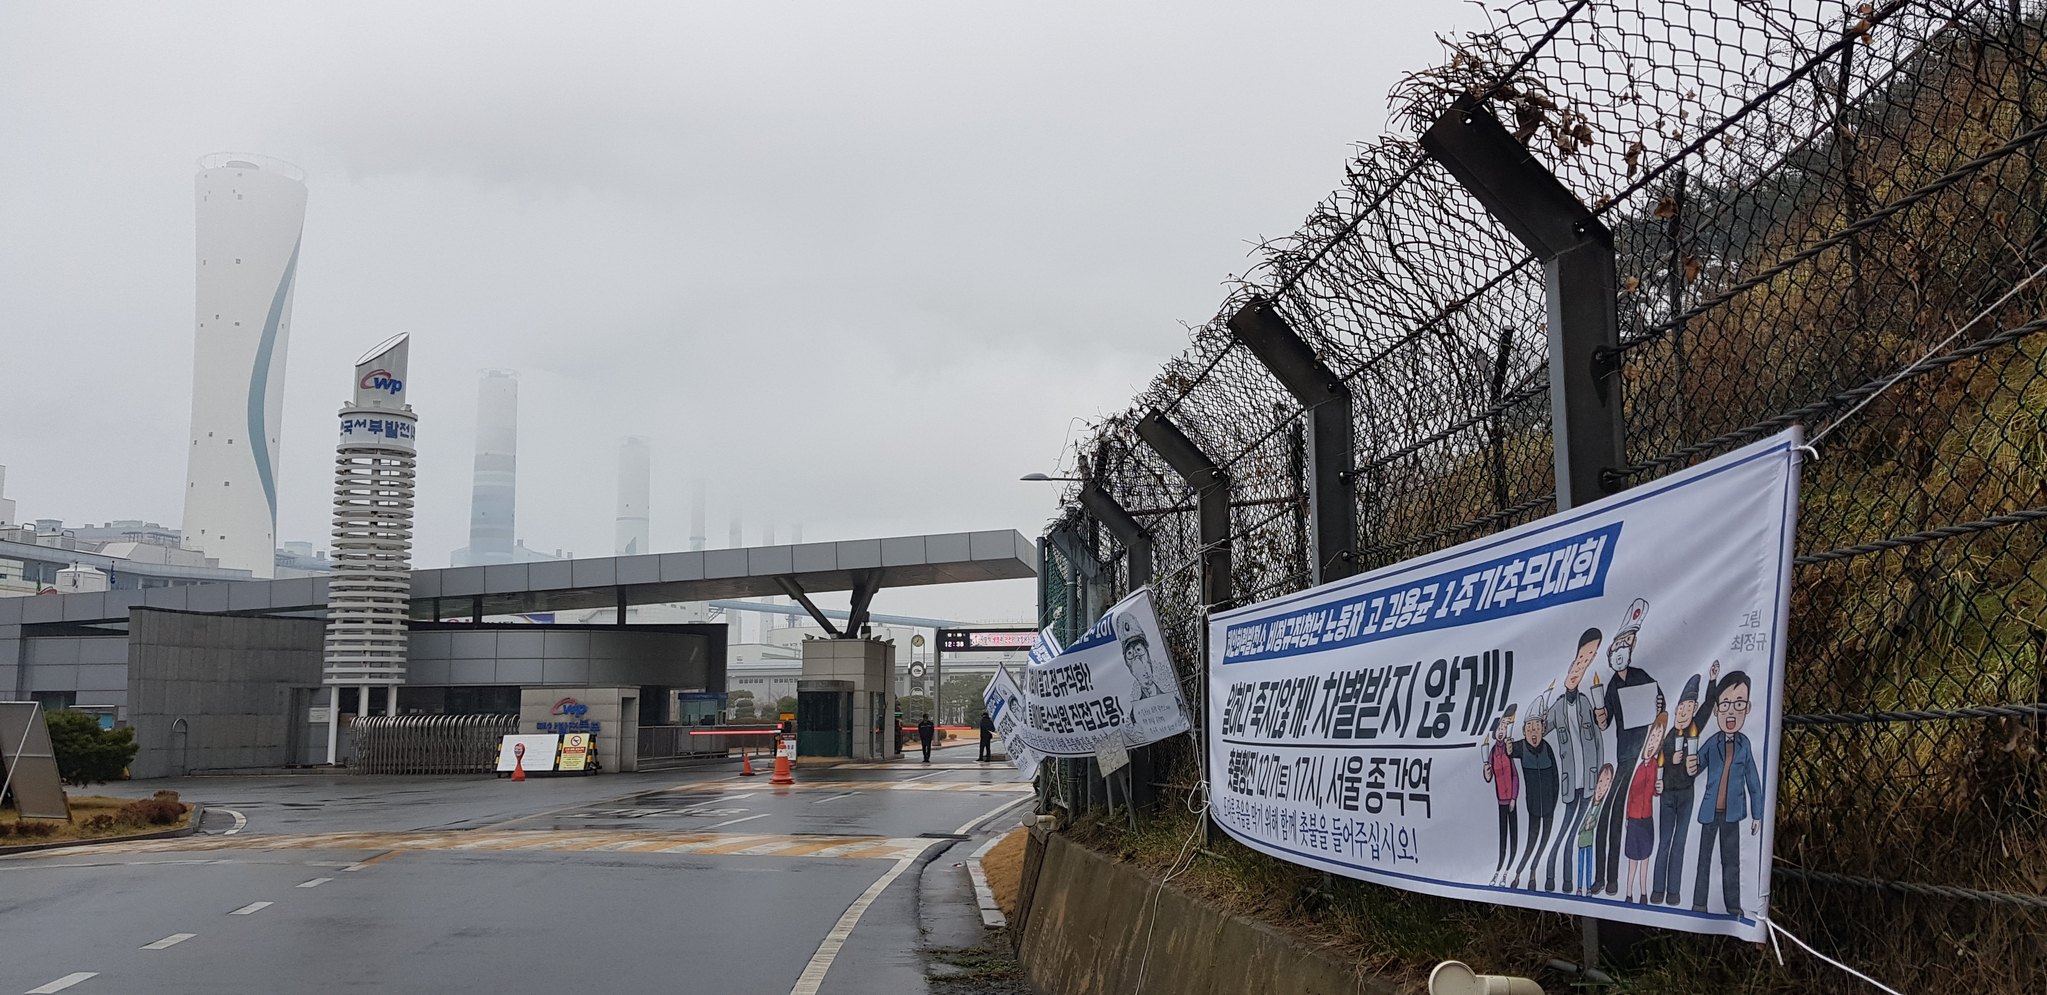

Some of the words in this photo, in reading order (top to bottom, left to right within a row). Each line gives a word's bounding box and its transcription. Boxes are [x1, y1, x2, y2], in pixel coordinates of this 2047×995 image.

[1265, 609, 1326, 651] 비정규직청년
[1322, 600, 1366, 642] 노동자
[1363, 597, 1385, 635] 고
[1380, 583, 1440, 632] 김용균
[1738, 609, 1762, 628] 그림
[1730, 632, 1767, 652] 최정규
[1049, 662, 1094, 697] 정규직화!
[1222, 681, 1257, 736] 일하다
[1250, 675, 1319, 738] 죽지않게!
[1312, 661, 1421, 739] 차별받지
[1416, 649, 1513, 739] 않게!
[1068, 696, 1125, 731] 직접고용!
[1227, 748, 1260, 796] 촛불행진
[1256, 753, 1292, 801] 12/7(토)
[1293, 755, 1325, 809] 17시,
[1251, 802, 1264, 836] 막기
[1264, 804, 1279, 841] 위해
[1280, 808, 1299, 845] 함께
[1299, 812, 1329, 850] 촛불을
[1331, 815, 1419, 864] 들어주십시오!
